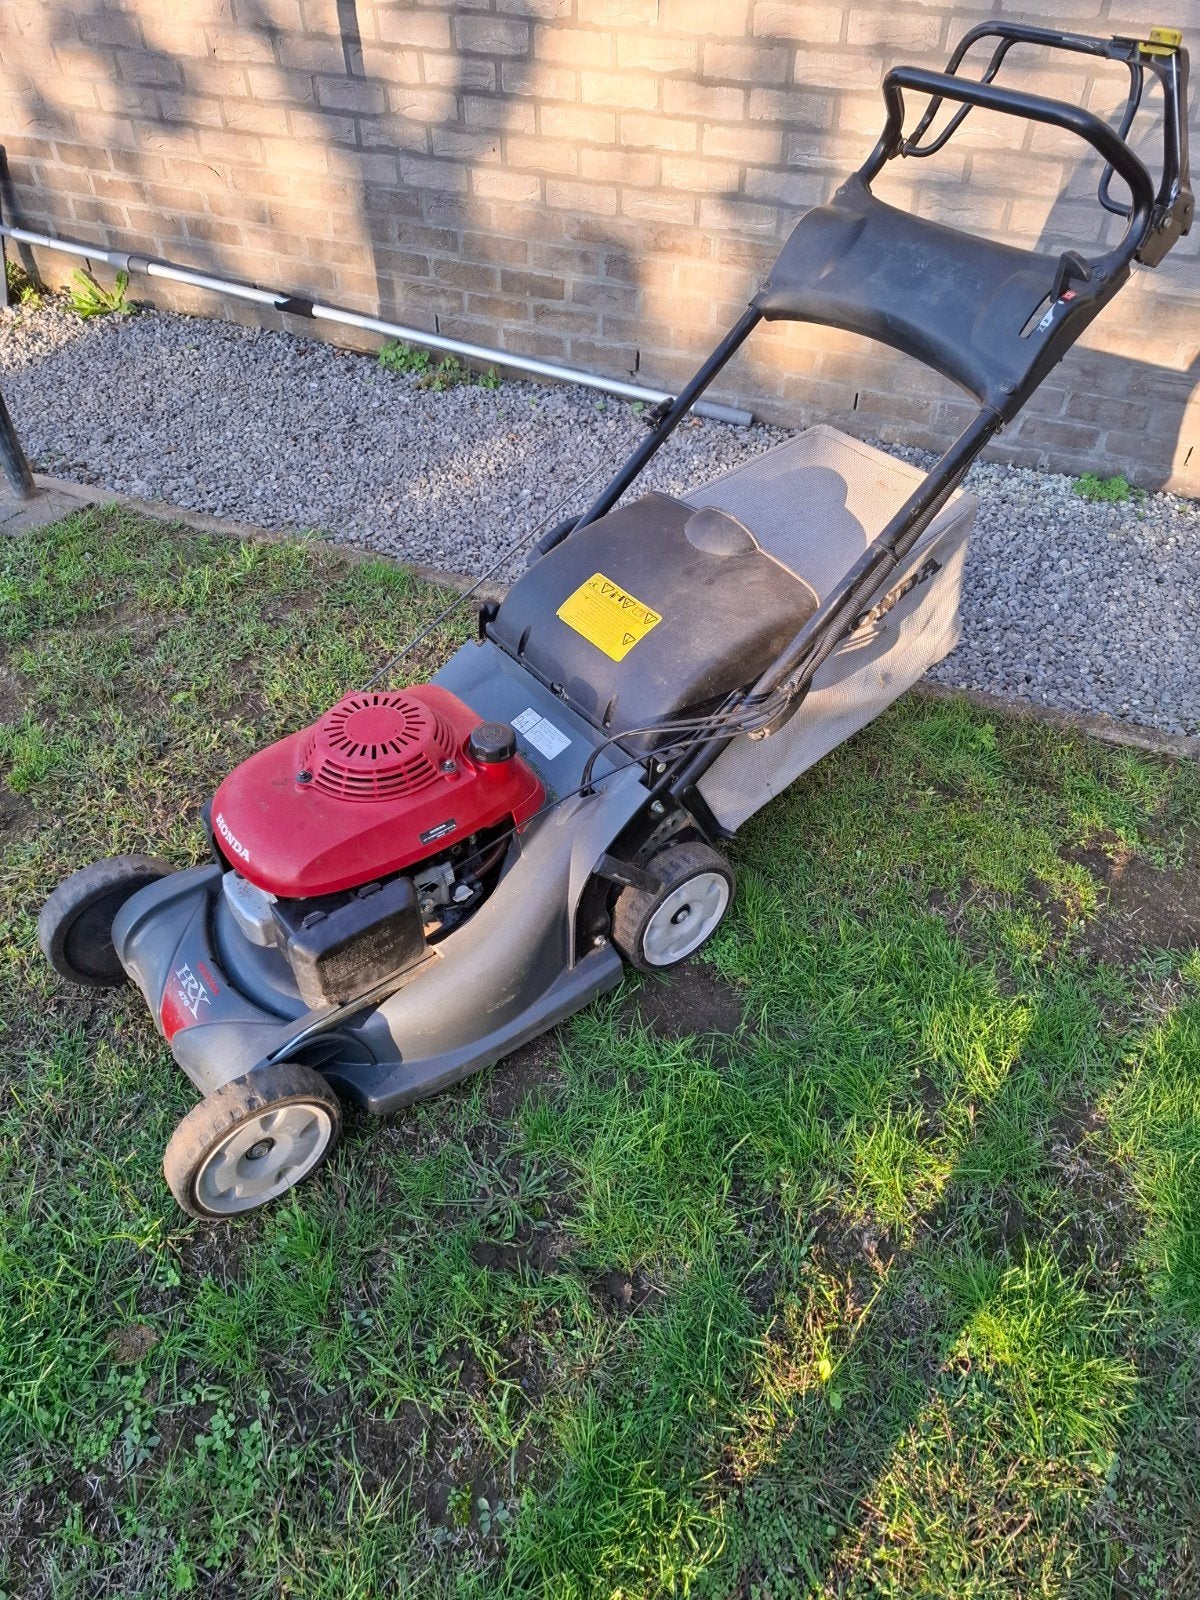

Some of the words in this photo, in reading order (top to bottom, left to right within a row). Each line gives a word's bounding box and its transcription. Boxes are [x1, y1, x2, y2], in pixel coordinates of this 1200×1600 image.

[843, 558, 942, 635] ONDA
[216, 812, 250, 863] HONDA
[175, 963, 211, 1020] HRX
